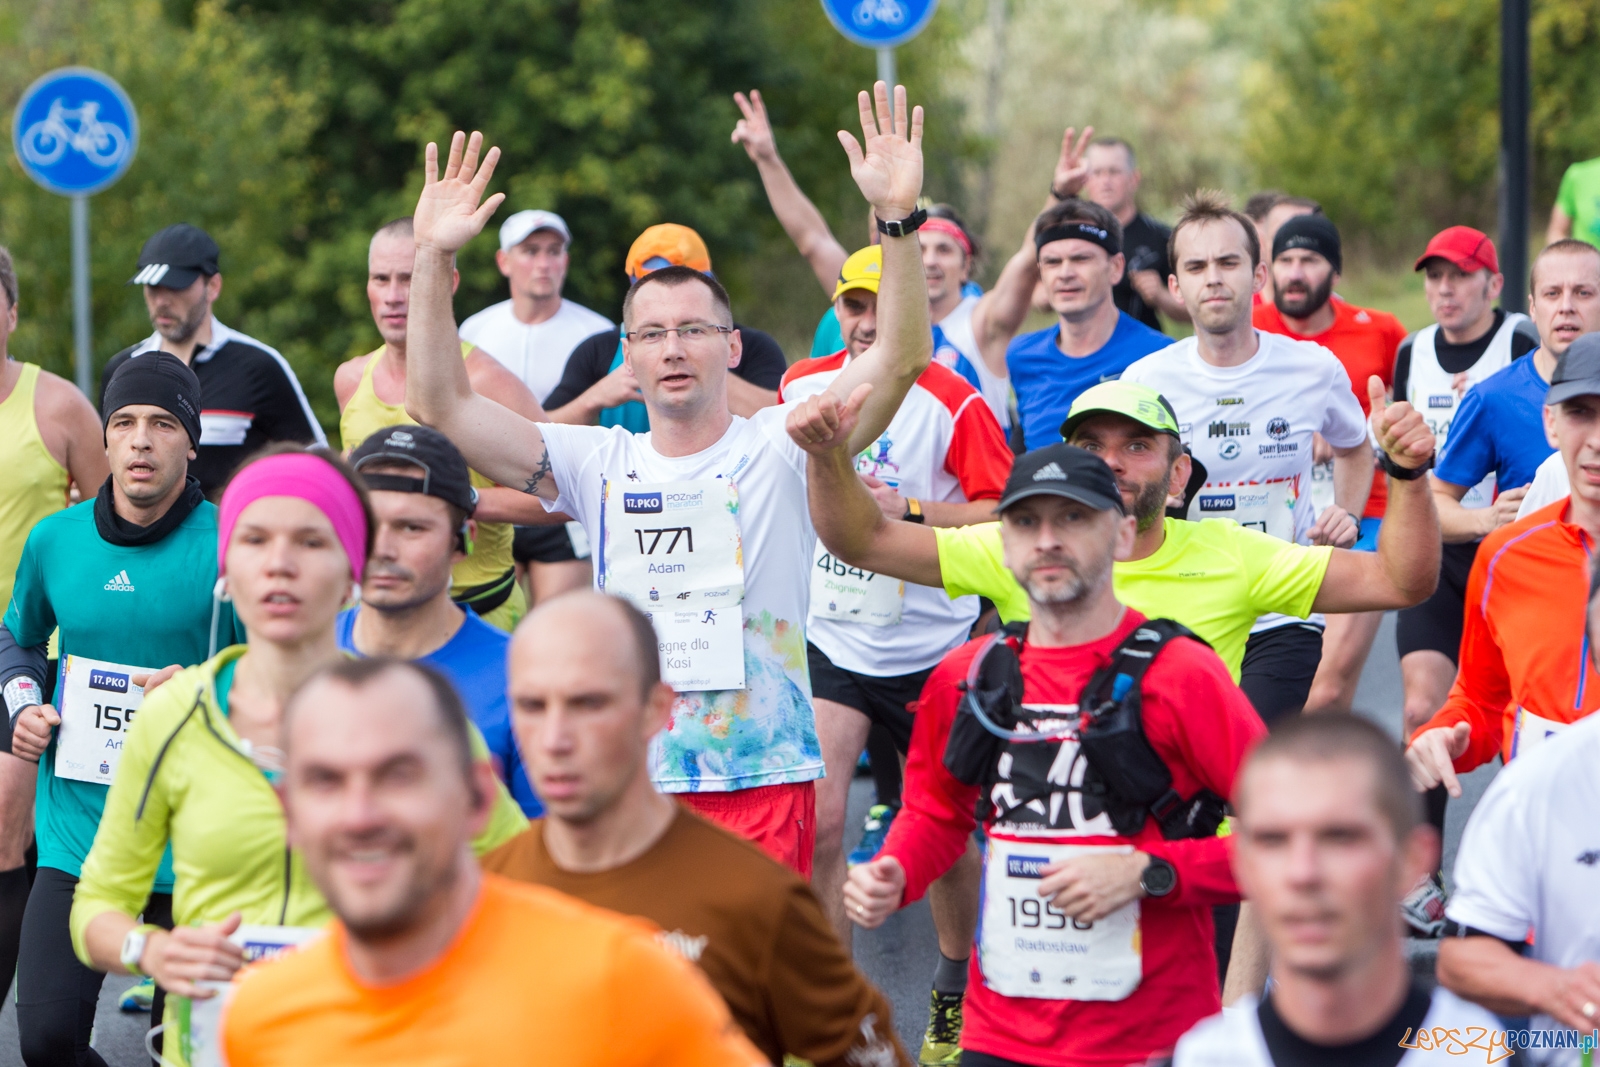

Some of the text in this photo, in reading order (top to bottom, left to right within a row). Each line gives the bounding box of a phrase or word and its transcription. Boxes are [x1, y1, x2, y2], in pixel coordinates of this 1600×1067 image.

[625, 498, 660, 509] 17.PKO
[635, 527, 693, 555] 1771
[648, 563, 685, 574] Adam
[104, 583, 135, 592] adidas
[824, 580, 867, 596] Zbigniew
[676, 591, 691, 600] 4F
[691, 638, 709, 650] dla
[667, 657, 691, 669] Kasi
[93, 674, 126, 688] 17.PKO
